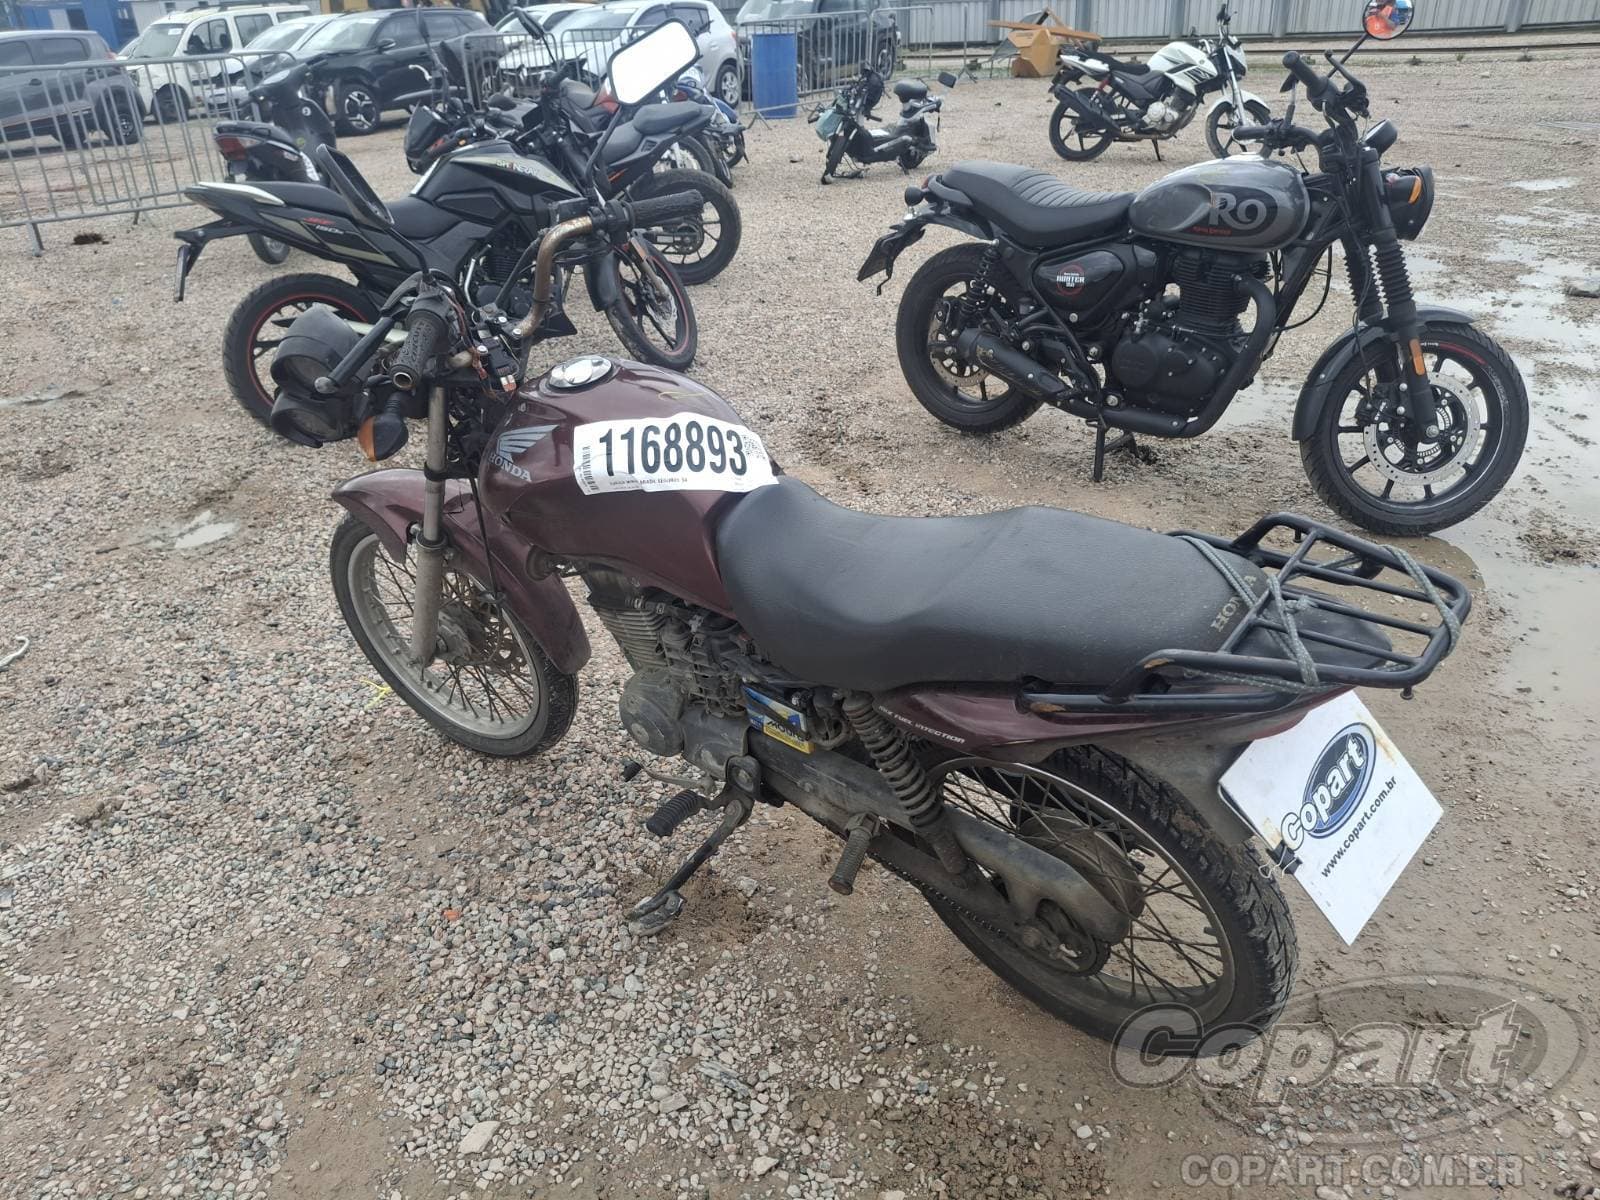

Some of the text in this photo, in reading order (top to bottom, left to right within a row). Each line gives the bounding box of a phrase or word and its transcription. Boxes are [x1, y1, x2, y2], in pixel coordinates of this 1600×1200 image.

[488, 452, 532, 482] HONDA
[599, 420, 748, 477] 1168893
[894, 714, 913, 727] FUEL
[915, 722, 965, 744] INJECTION
[1281, 733, 1366, 851] Copart
[1321, 775, 1398, 878] www.copart.com.br
